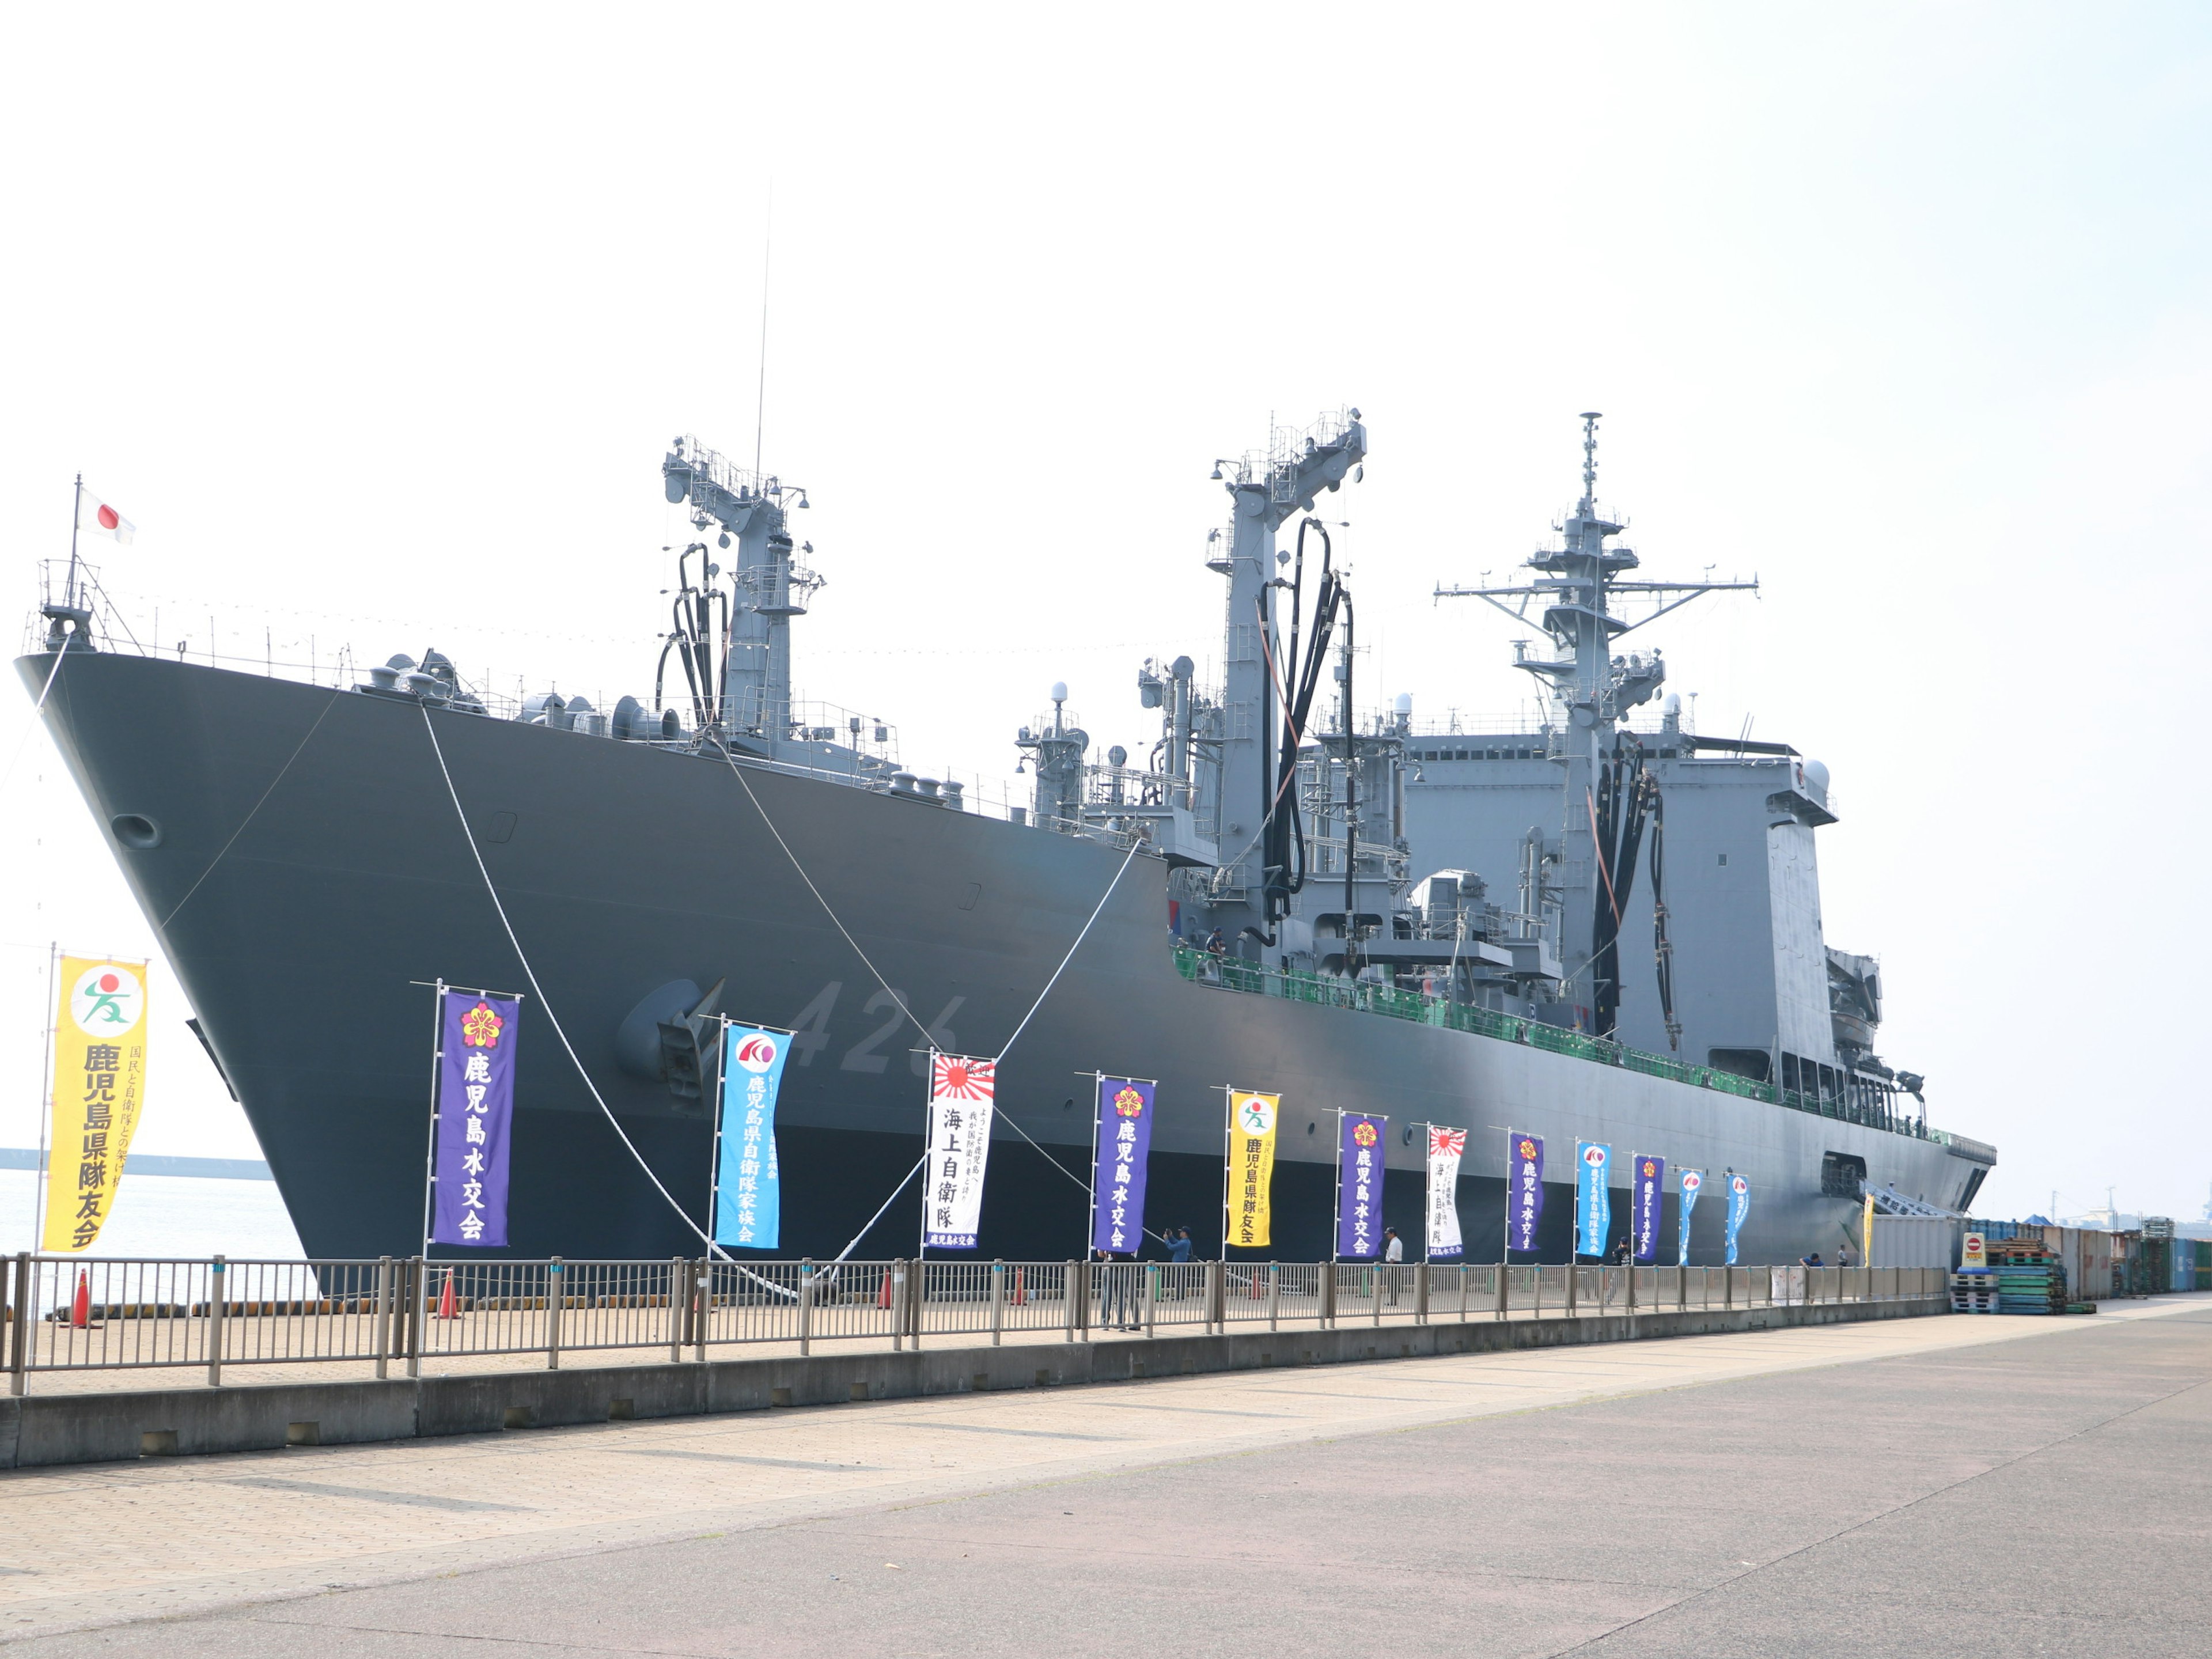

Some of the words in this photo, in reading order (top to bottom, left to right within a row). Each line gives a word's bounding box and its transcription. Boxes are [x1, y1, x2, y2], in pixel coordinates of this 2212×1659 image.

[785, 980, 967, 1077] 426
[72, 1043, 121, 1248] 鹿児島県隊友会
[459, 1051, 491, 1240] 鹿児島水交会
[738, 1075, 766, 1243] 鹿児島県自衛隊家族会
[937, 1108, 963, 1228] 海上自衛隊
[972, 1108, 987, 1183] ようこそ鹿児島へ
[1111, 1119, 1137, 1248] 鹿児島水交会
[1239, 1138, 1262, 1243] 鹿児島県隊友会
[929, 1234, 975, 1246] 鹿児島水交会
[1353, 1148, 1372, 1254] 鹿児島水交会
[1521, 1161, 1537, 1249] 鹿児島水交会
[1641, 1181, 1654, 1255] 鹿児島水交会
